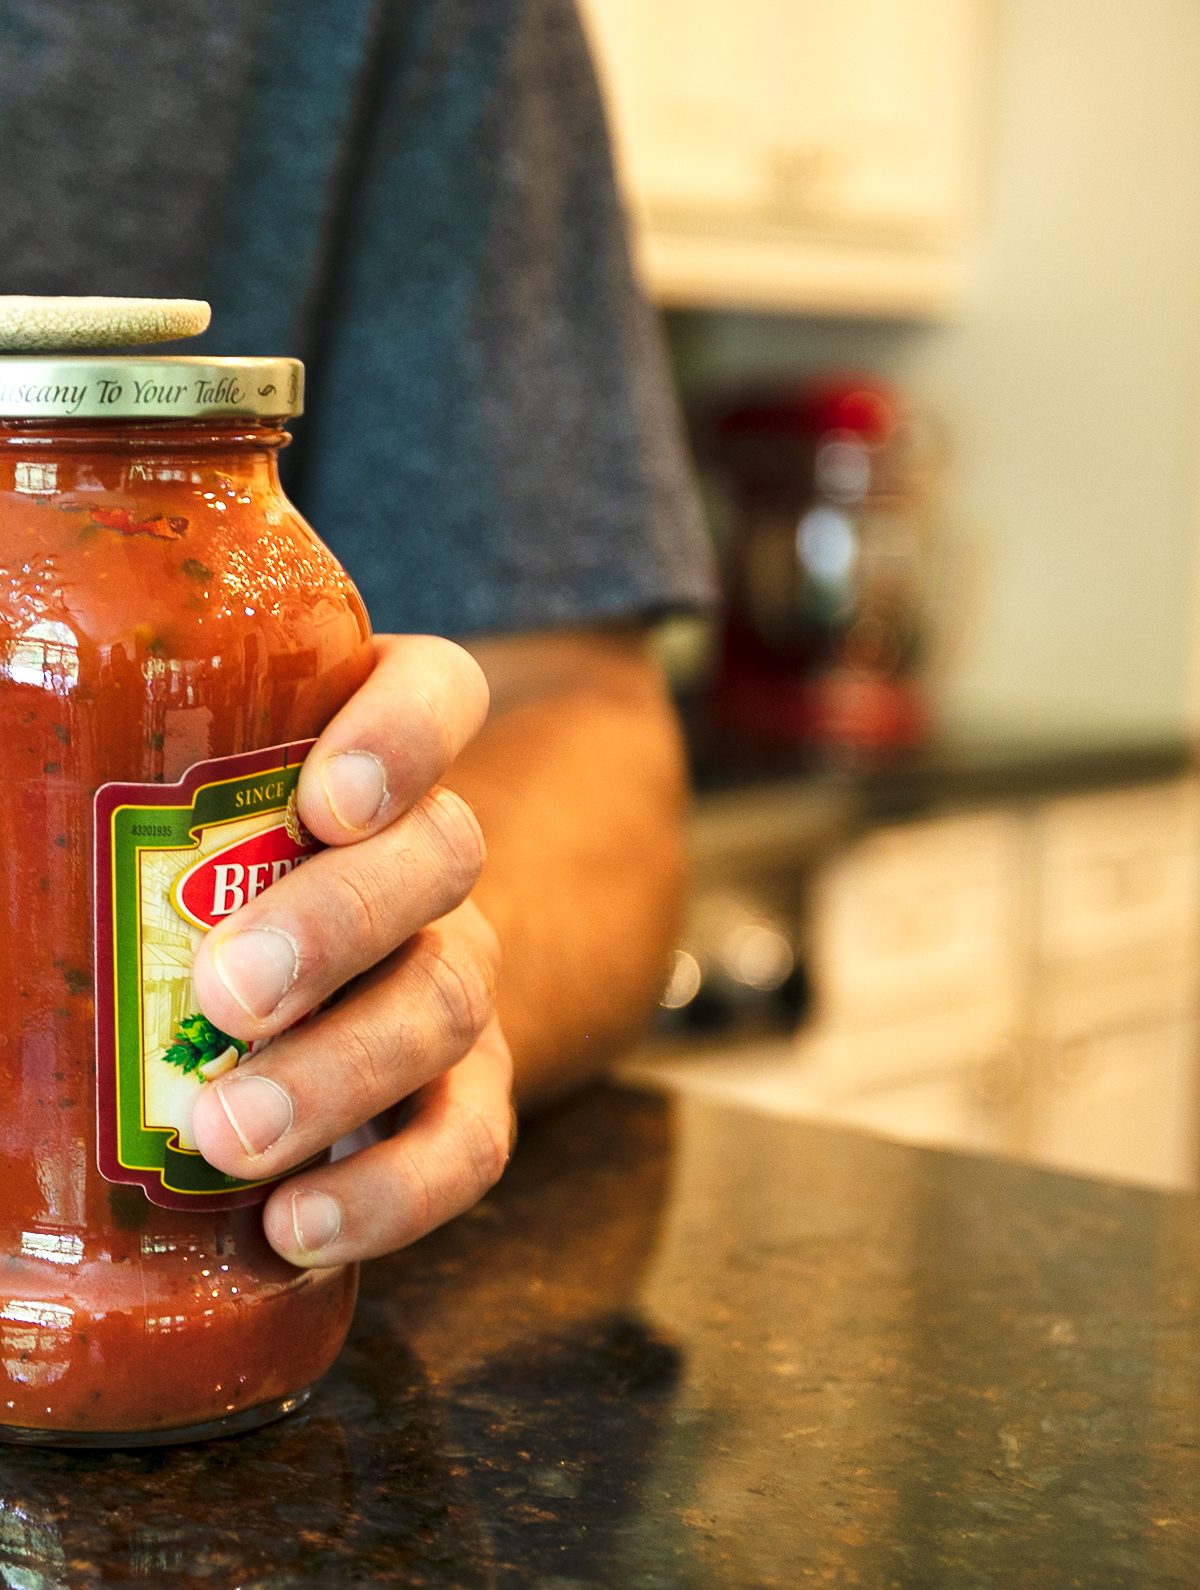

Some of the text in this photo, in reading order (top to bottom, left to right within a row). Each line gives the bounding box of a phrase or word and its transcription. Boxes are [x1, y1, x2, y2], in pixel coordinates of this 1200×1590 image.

[97, 380, 123, 404] To
[133, 379, 187, 404] Your
[195, 377, 246, 404] Table
[235, 781, 285, 808] SINCE
